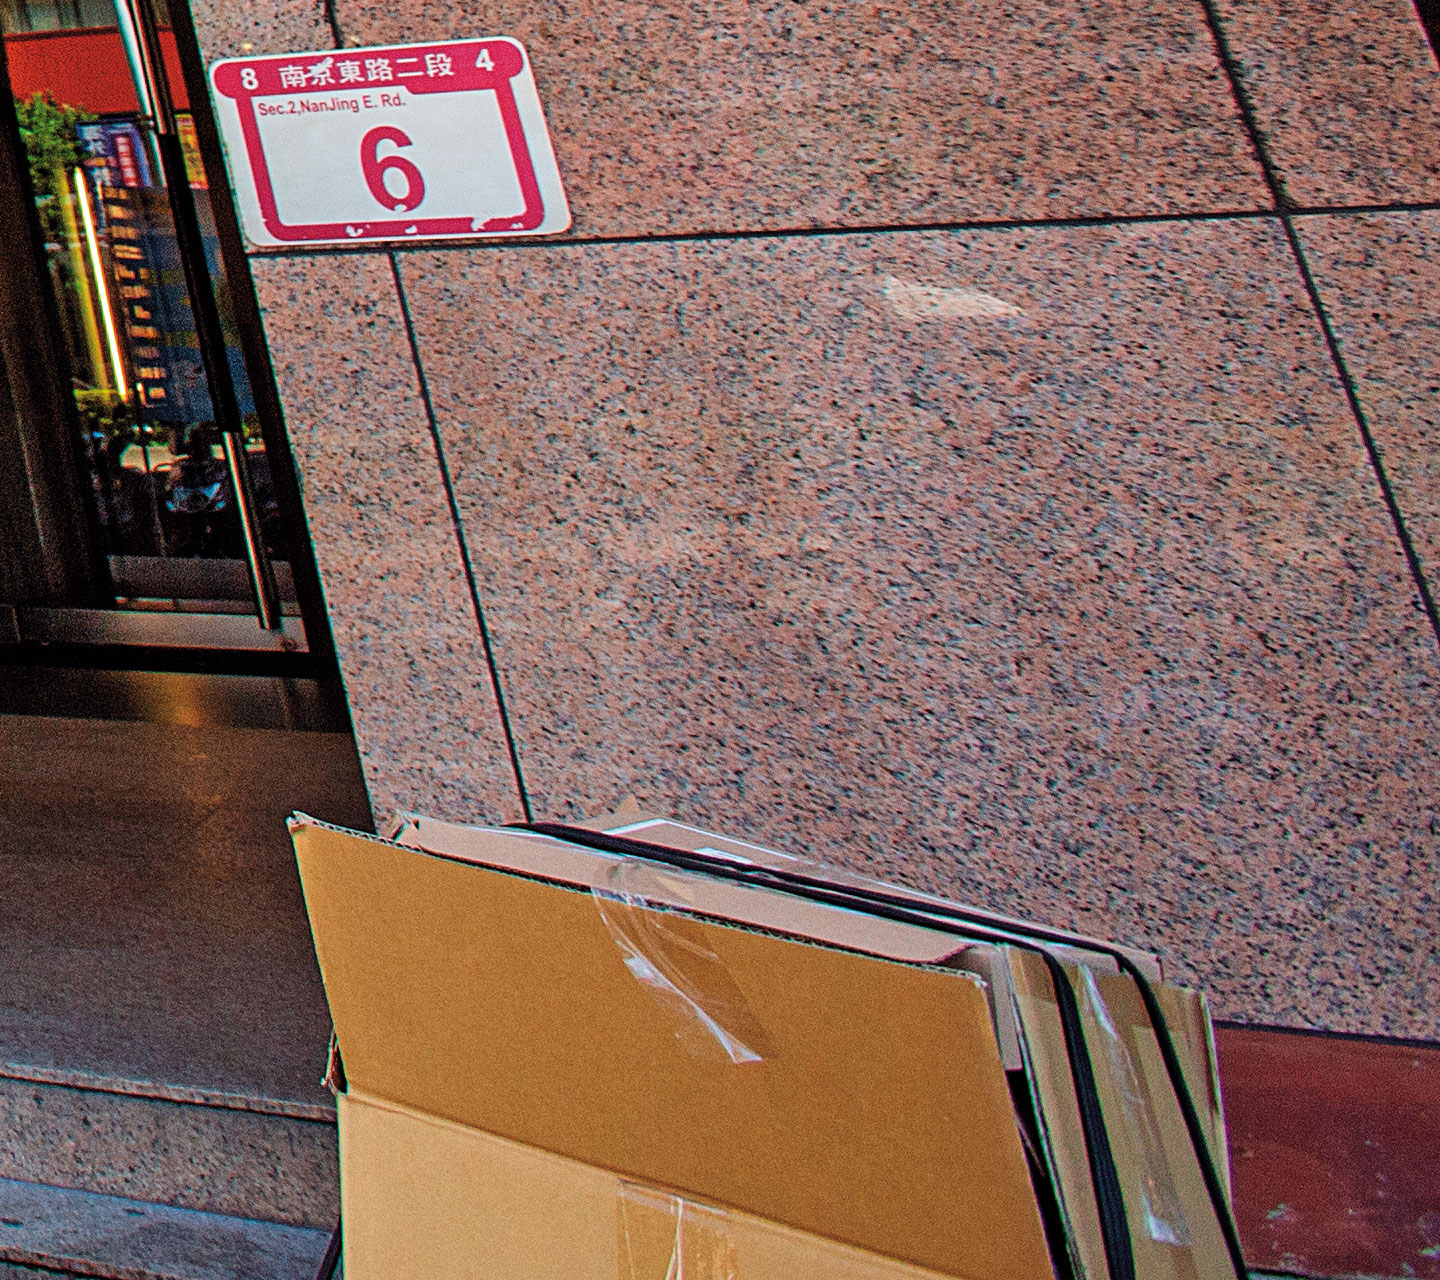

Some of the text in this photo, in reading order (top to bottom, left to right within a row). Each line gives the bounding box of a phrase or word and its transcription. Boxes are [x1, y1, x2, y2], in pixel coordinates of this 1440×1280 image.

[240, 49, 495, 90] 8 南京東路二段 4
[363, 96, 377, 109] E.
[381, 93, 407, 108] Rd.
[359, 125, 426, 213] 6
